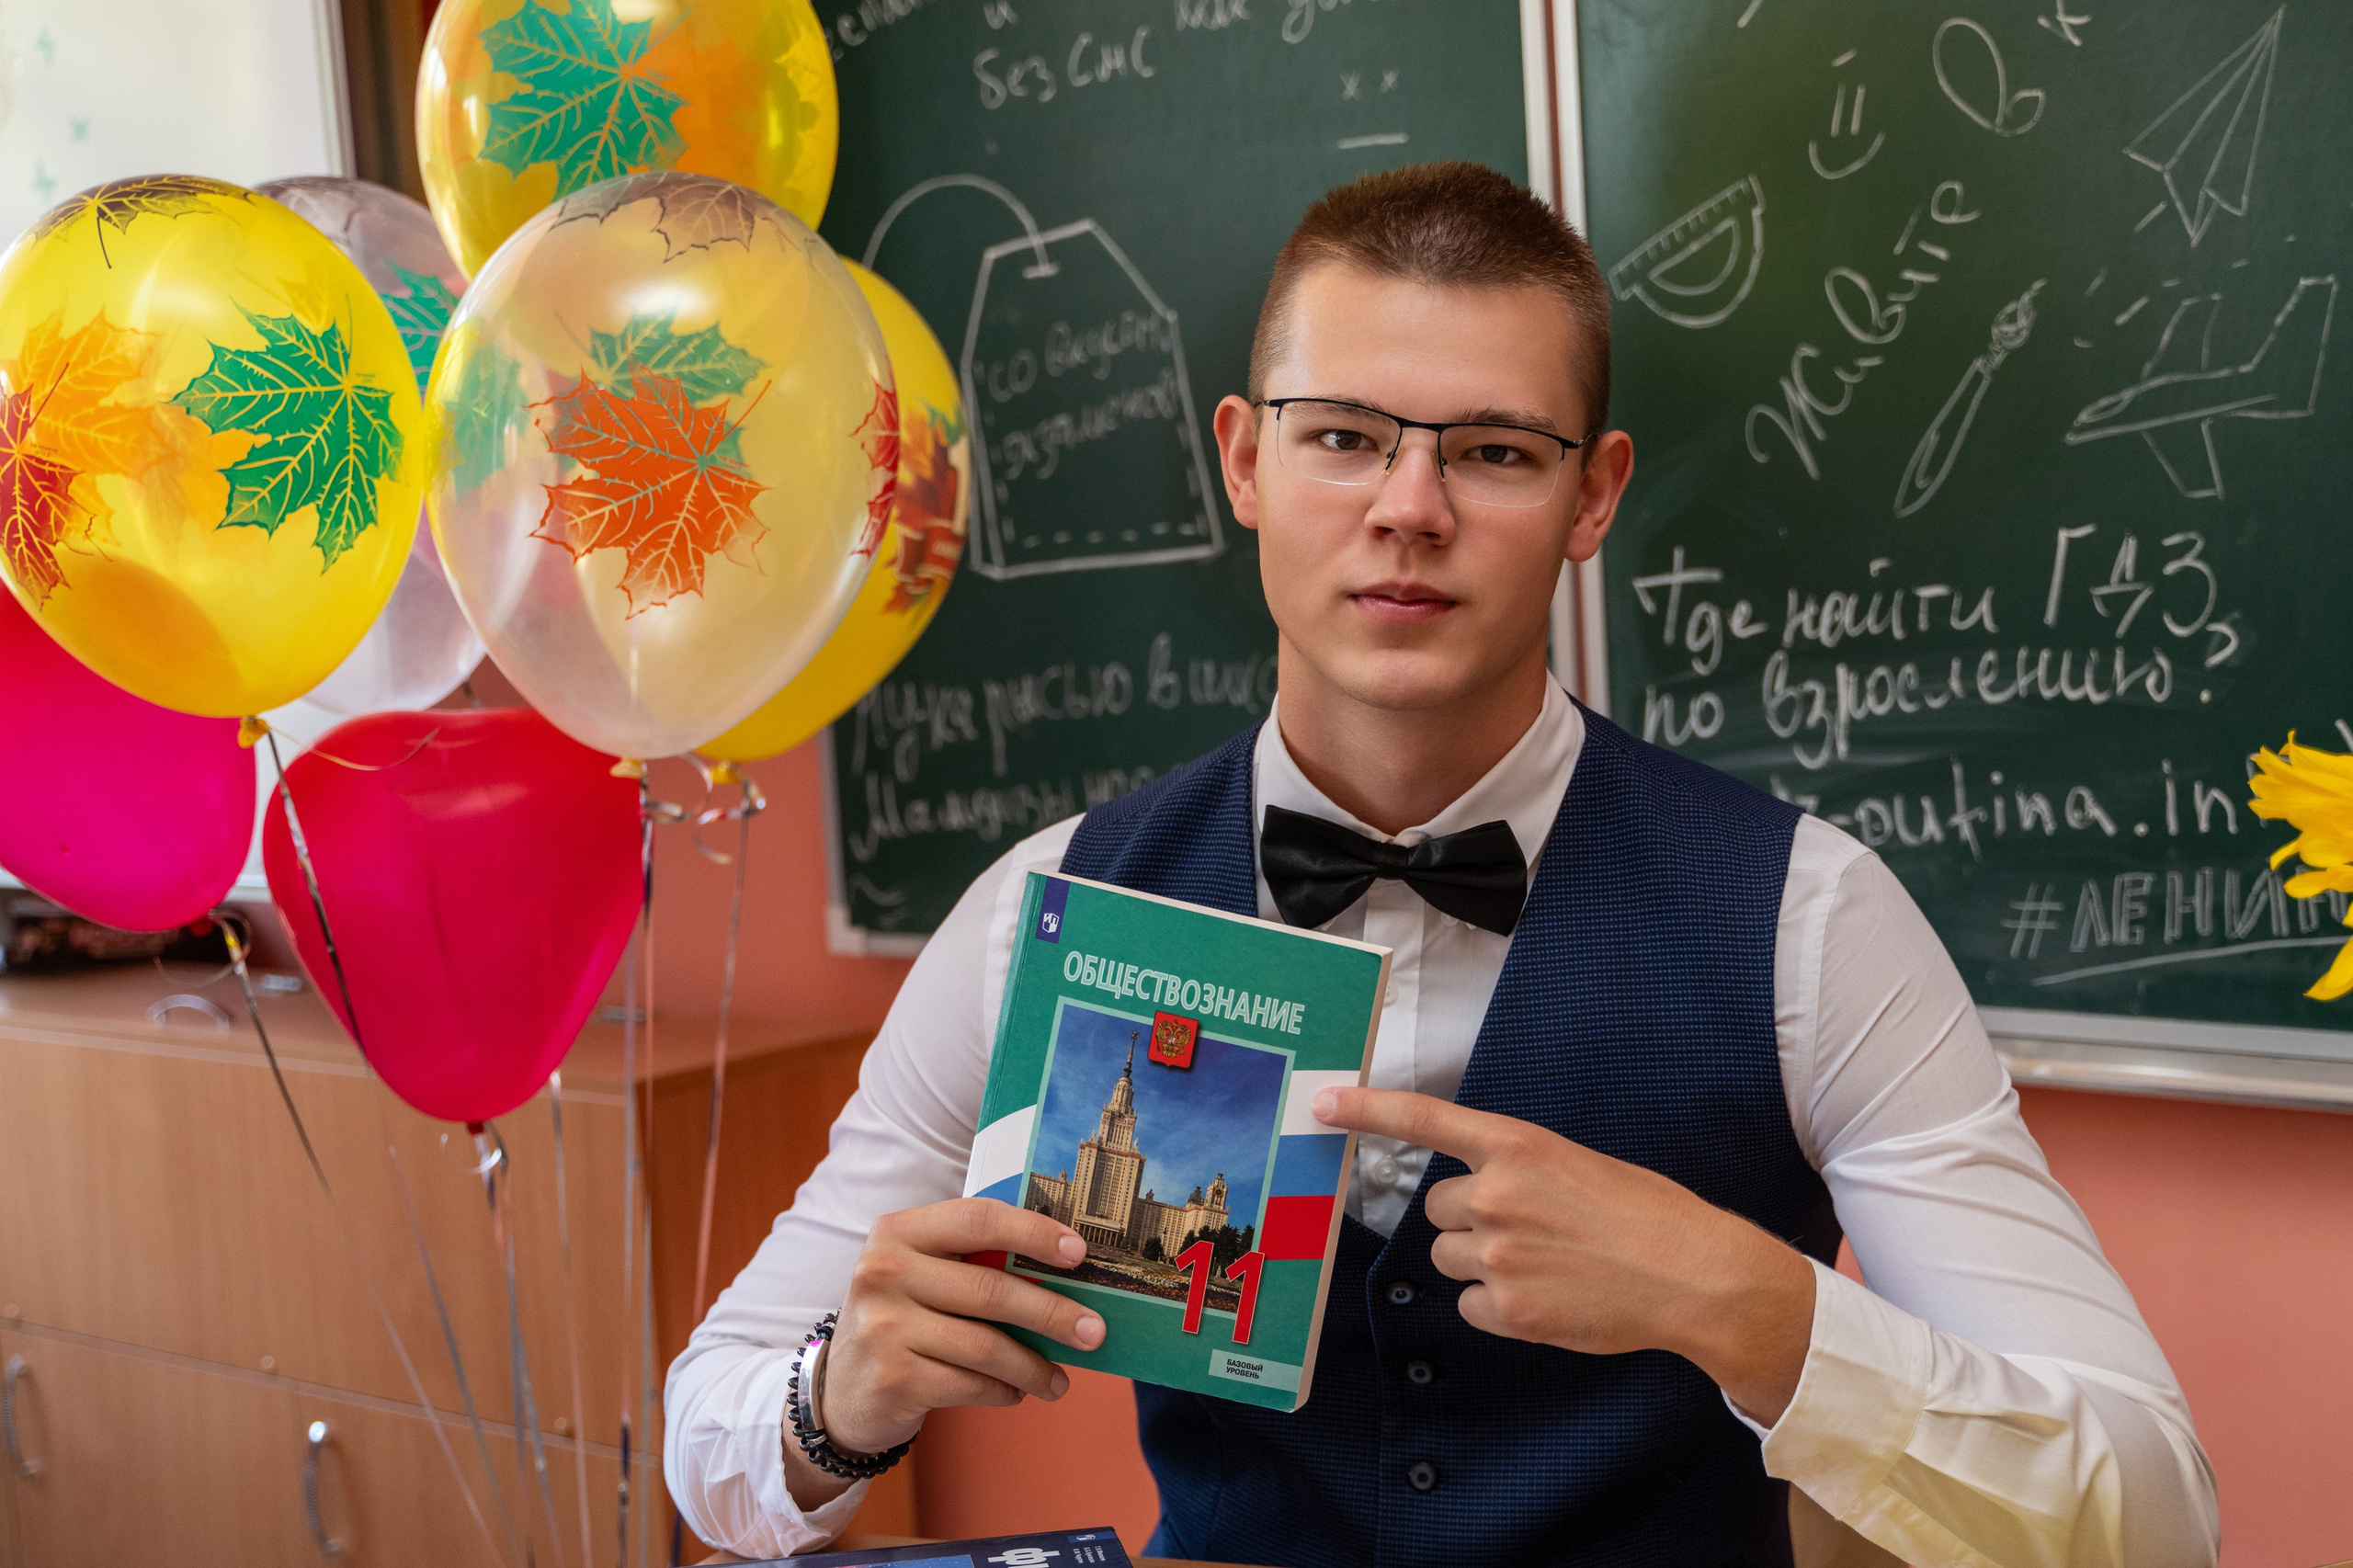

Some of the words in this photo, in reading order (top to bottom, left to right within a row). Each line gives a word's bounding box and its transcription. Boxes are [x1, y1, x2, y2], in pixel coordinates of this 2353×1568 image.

[972, 46, 1058, 109] без
[987, 347, 1039, 403] со
[1781, 555, 2001, 649] найти
[2042, 522, 2219, 640] ГДЗ
[1642, 685, 1725, 746] по
[1063, 950, 1305, 1035] ОБЩЕСТВОЗНАНИЕ
[1174, 1240, 1265, 1345] 11
[1225, 1367, 1260, 1380] УРОВЕНЬ
[1227, 1358, 1264, 1372] БАЗОВЫЙ
